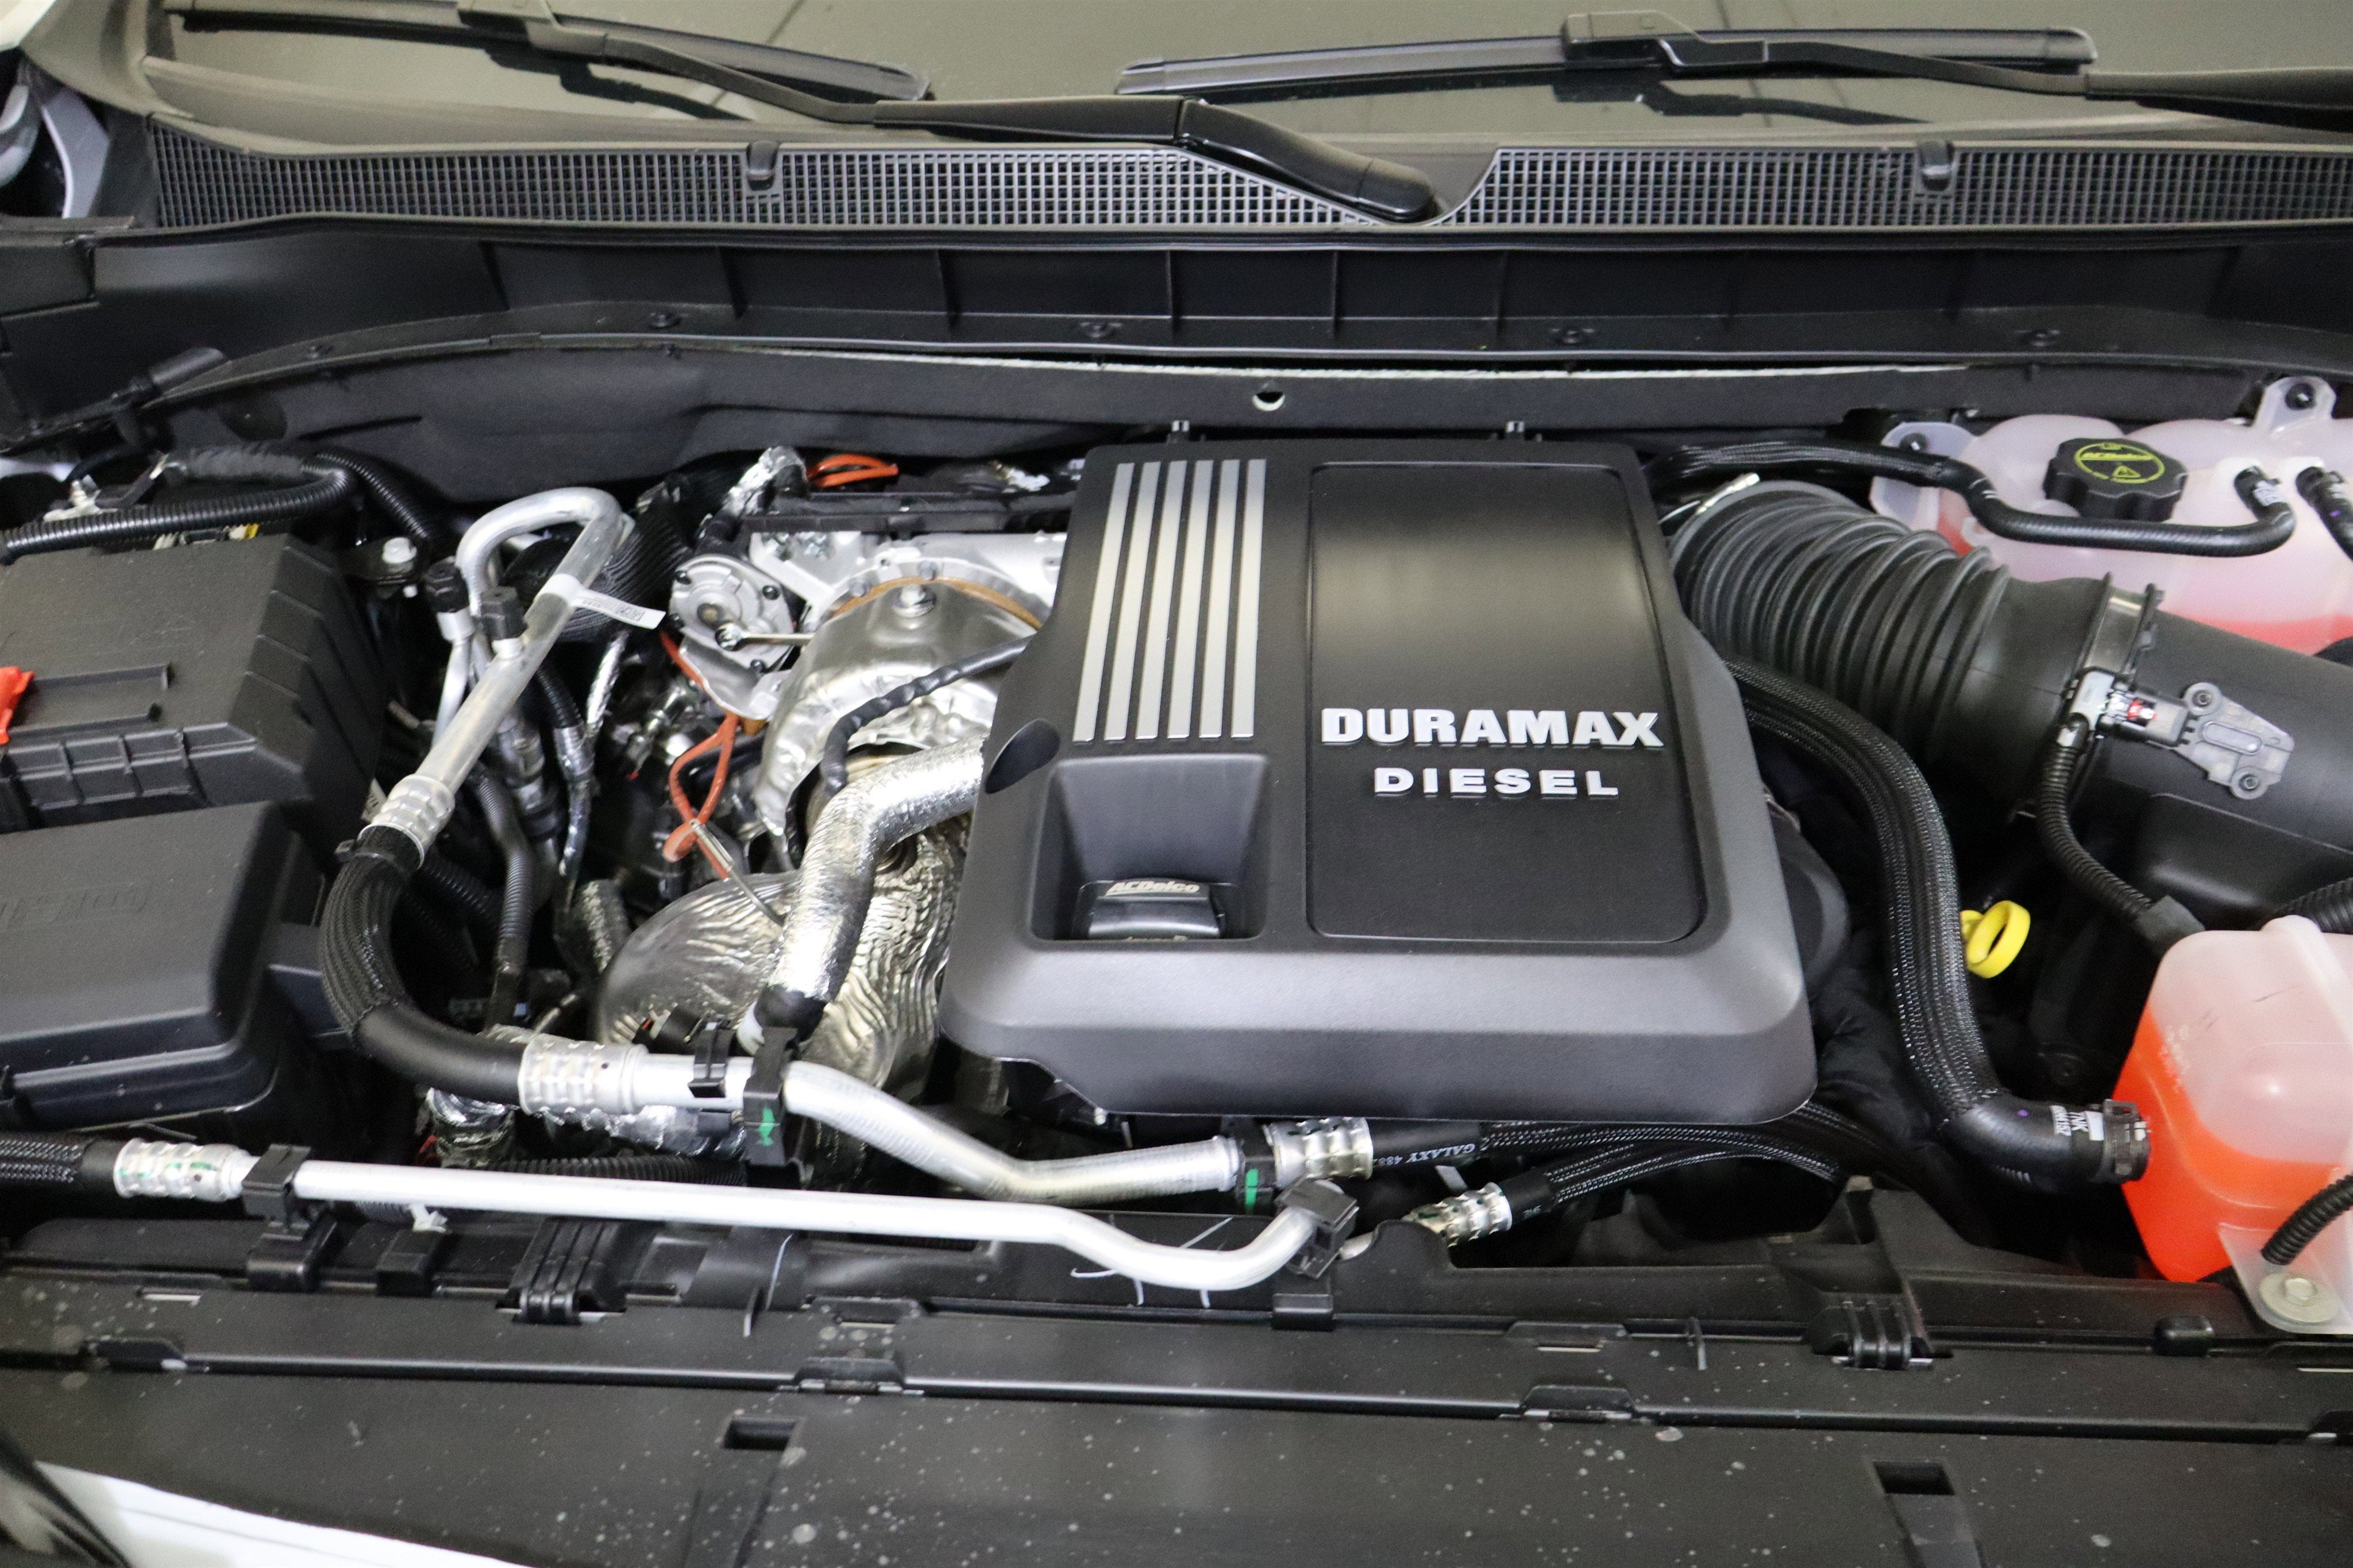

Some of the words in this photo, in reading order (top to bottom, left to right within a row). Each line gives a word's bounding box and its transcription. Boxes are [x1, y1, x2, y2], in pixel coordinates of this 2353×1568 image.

[1321, 708, 1664, 747] DURAMAX
[1374, 767, 1619, 796] DIESEL
[1106, 880, 1200, 894] ACDelco
[1406, 1144, 1475, 1163] GALAXY
